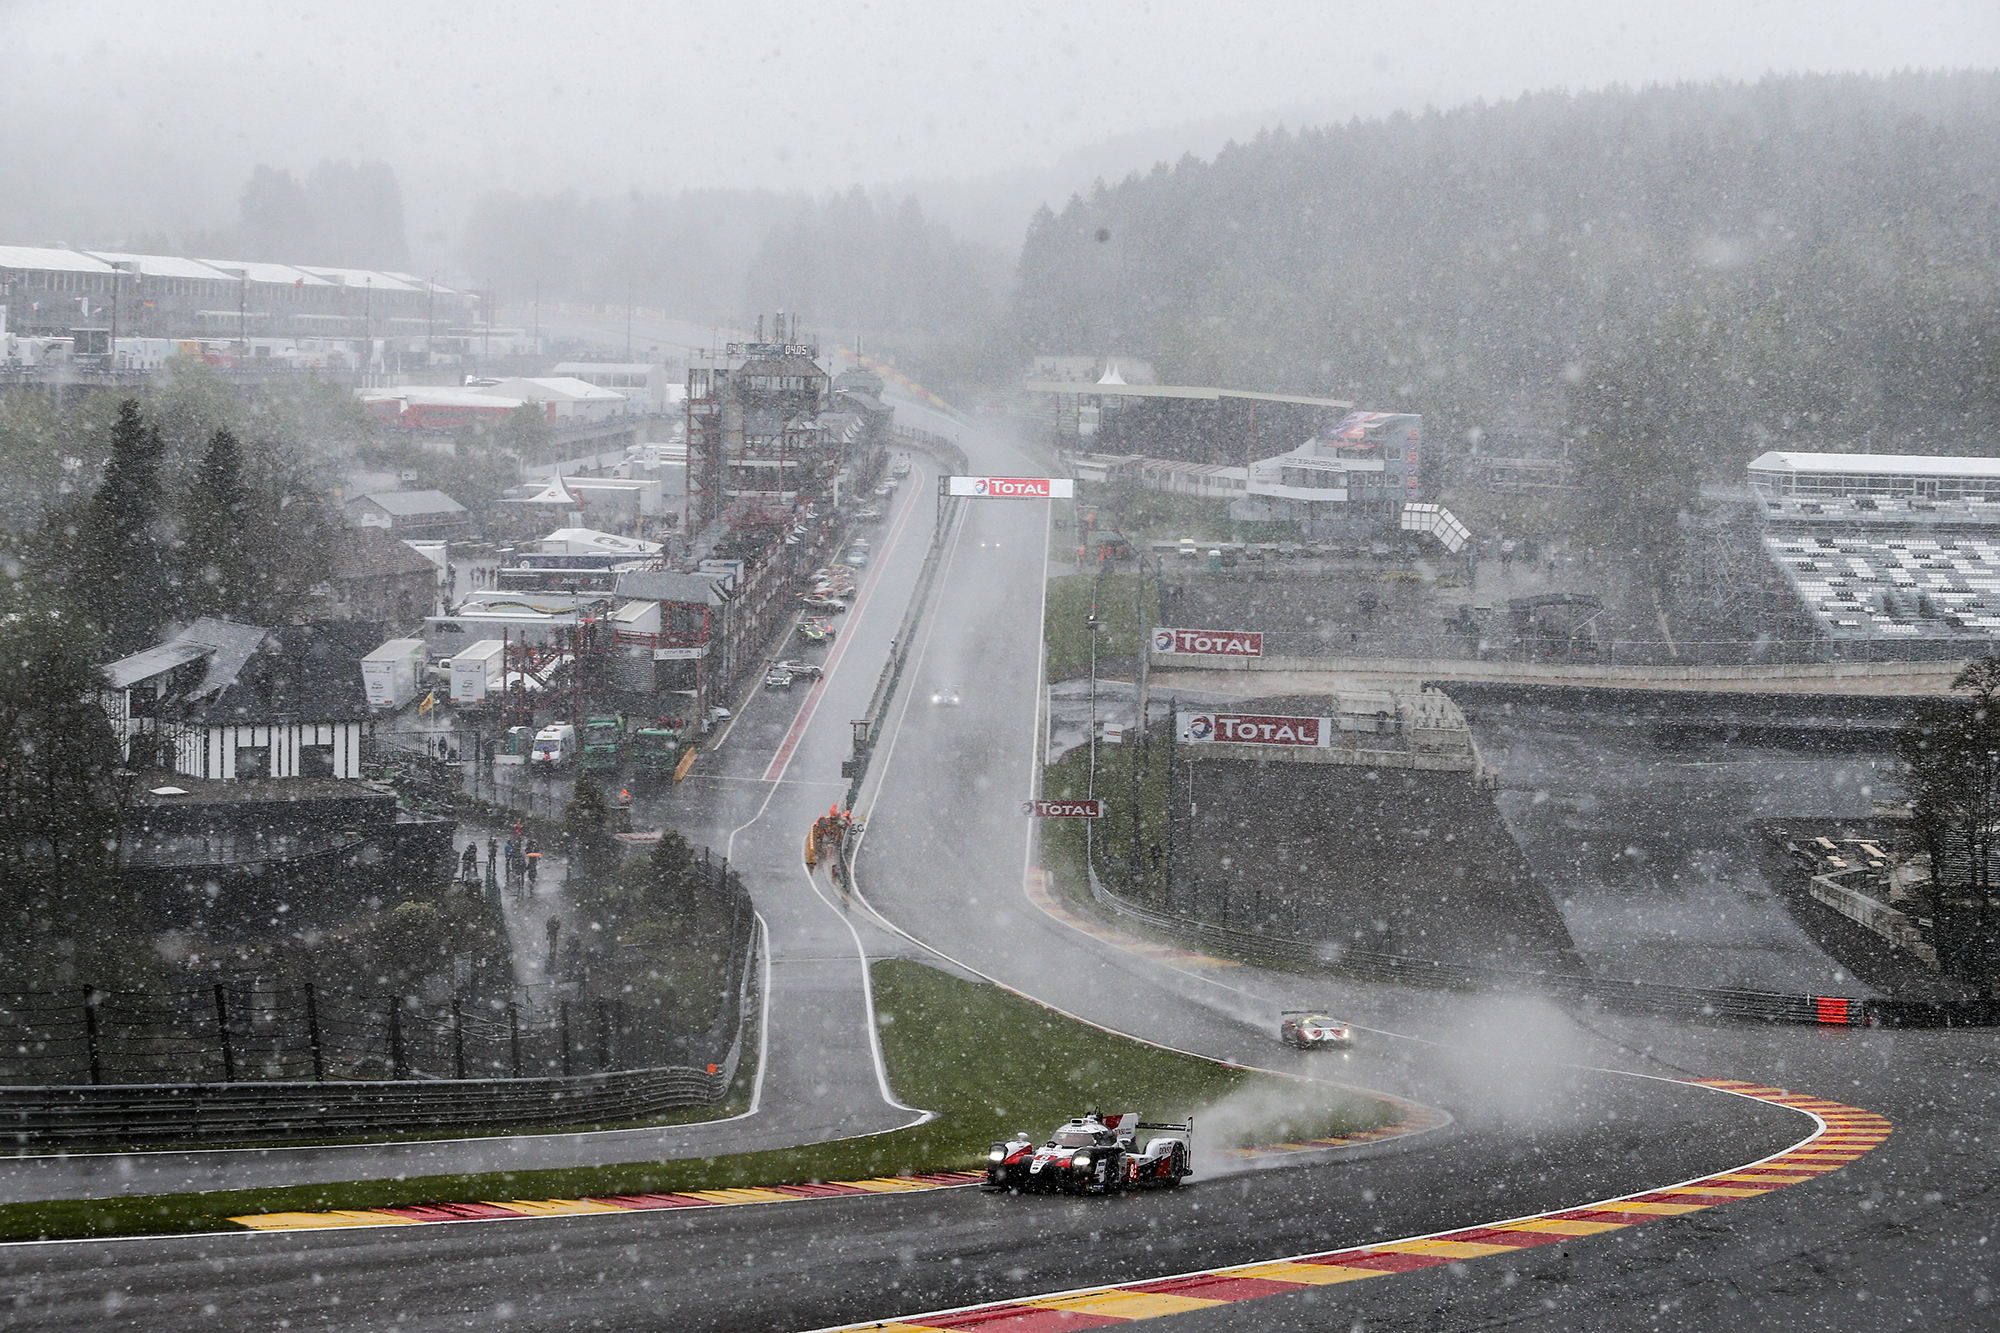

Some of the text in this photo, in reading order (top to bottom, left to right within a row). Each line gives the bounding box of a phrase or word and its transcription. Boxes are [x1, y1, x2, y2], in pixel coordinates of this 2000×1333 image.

[991, 480, 1048, 495] TOTAL
[1179, 633, 1259, 653] TOTAL
[1219, 718, 1315, 742] TOTAL
[1038, 802, 1097, 816] TOTAL
[850, 823, 865, 836] SC
[1129, 1163, 1135, 1178] 8
